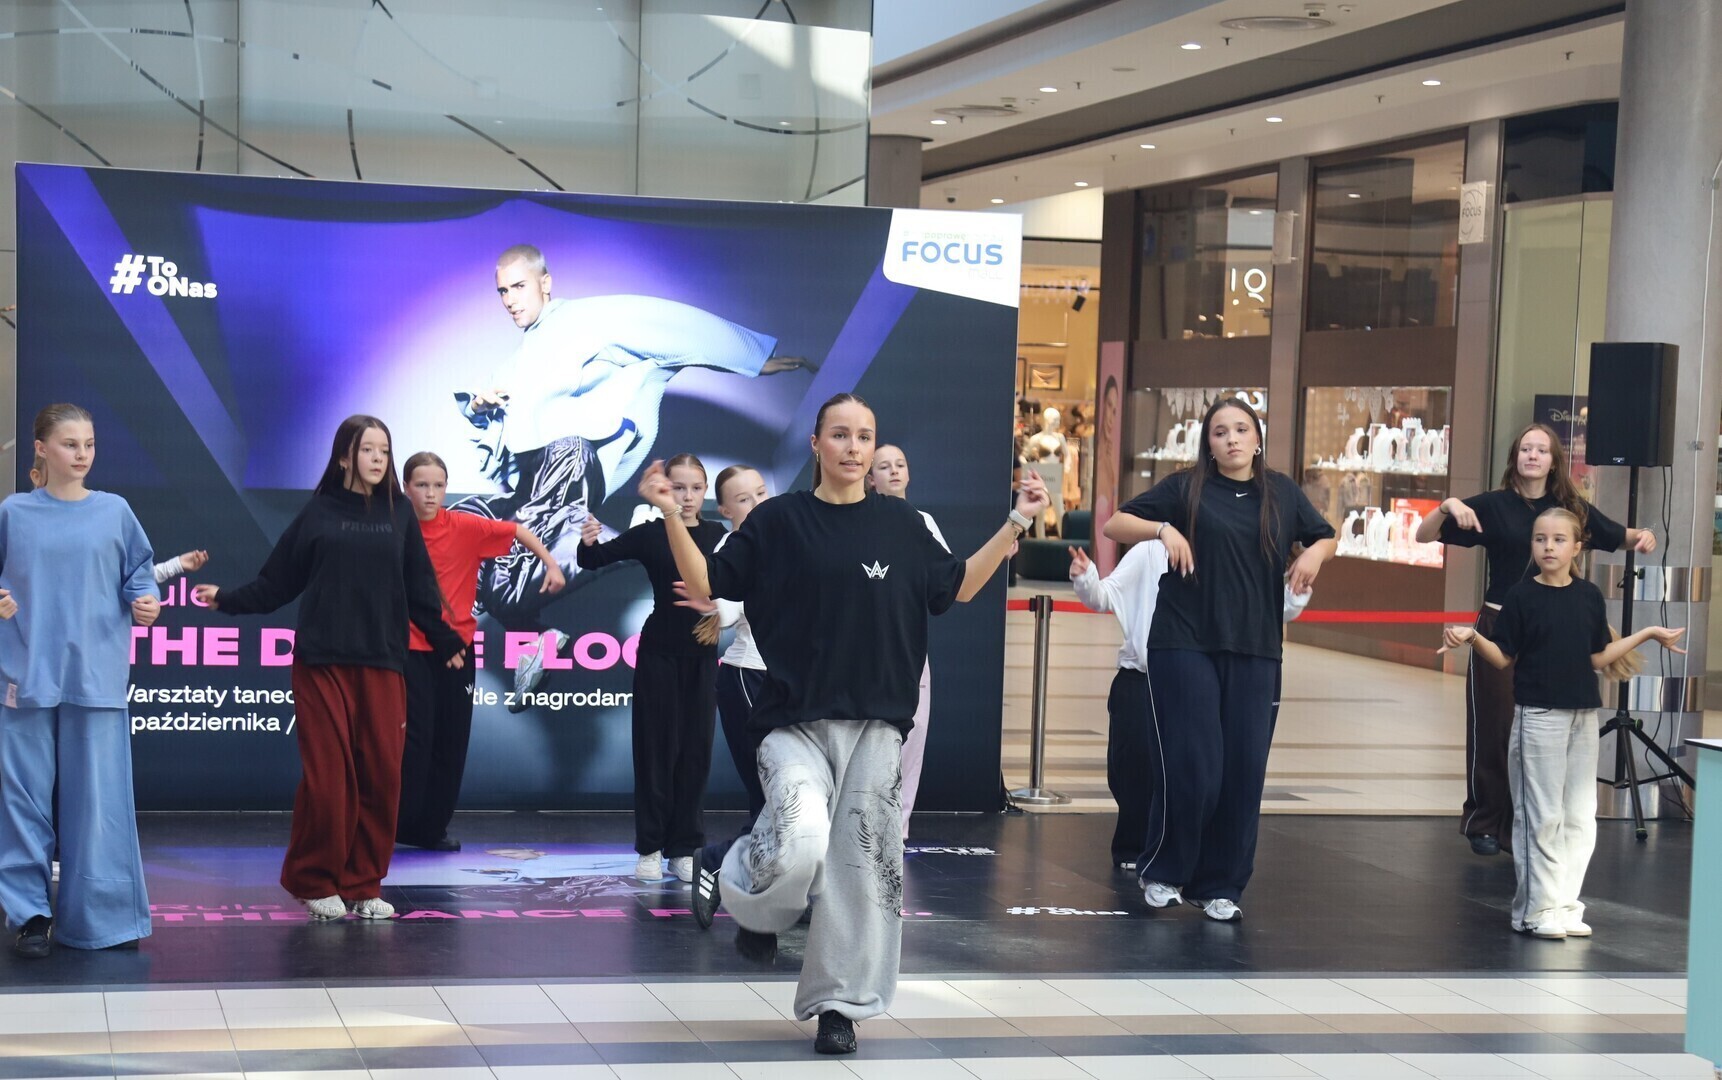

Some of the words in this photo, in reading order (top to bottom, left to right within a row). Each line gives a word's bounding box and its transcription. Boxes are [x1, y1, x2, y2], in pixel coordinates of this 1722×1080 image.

[902, 241, 1004, 266] FOCUS
[159, 577, 209, 607] ule
[504, 631, 642, 670] FLO
[504, 691, 516, 705] z
[522, 688, 633, 712] nagrodam
[131, 711, 281, 735] października
[396, 908, 628, 919] ANCE
